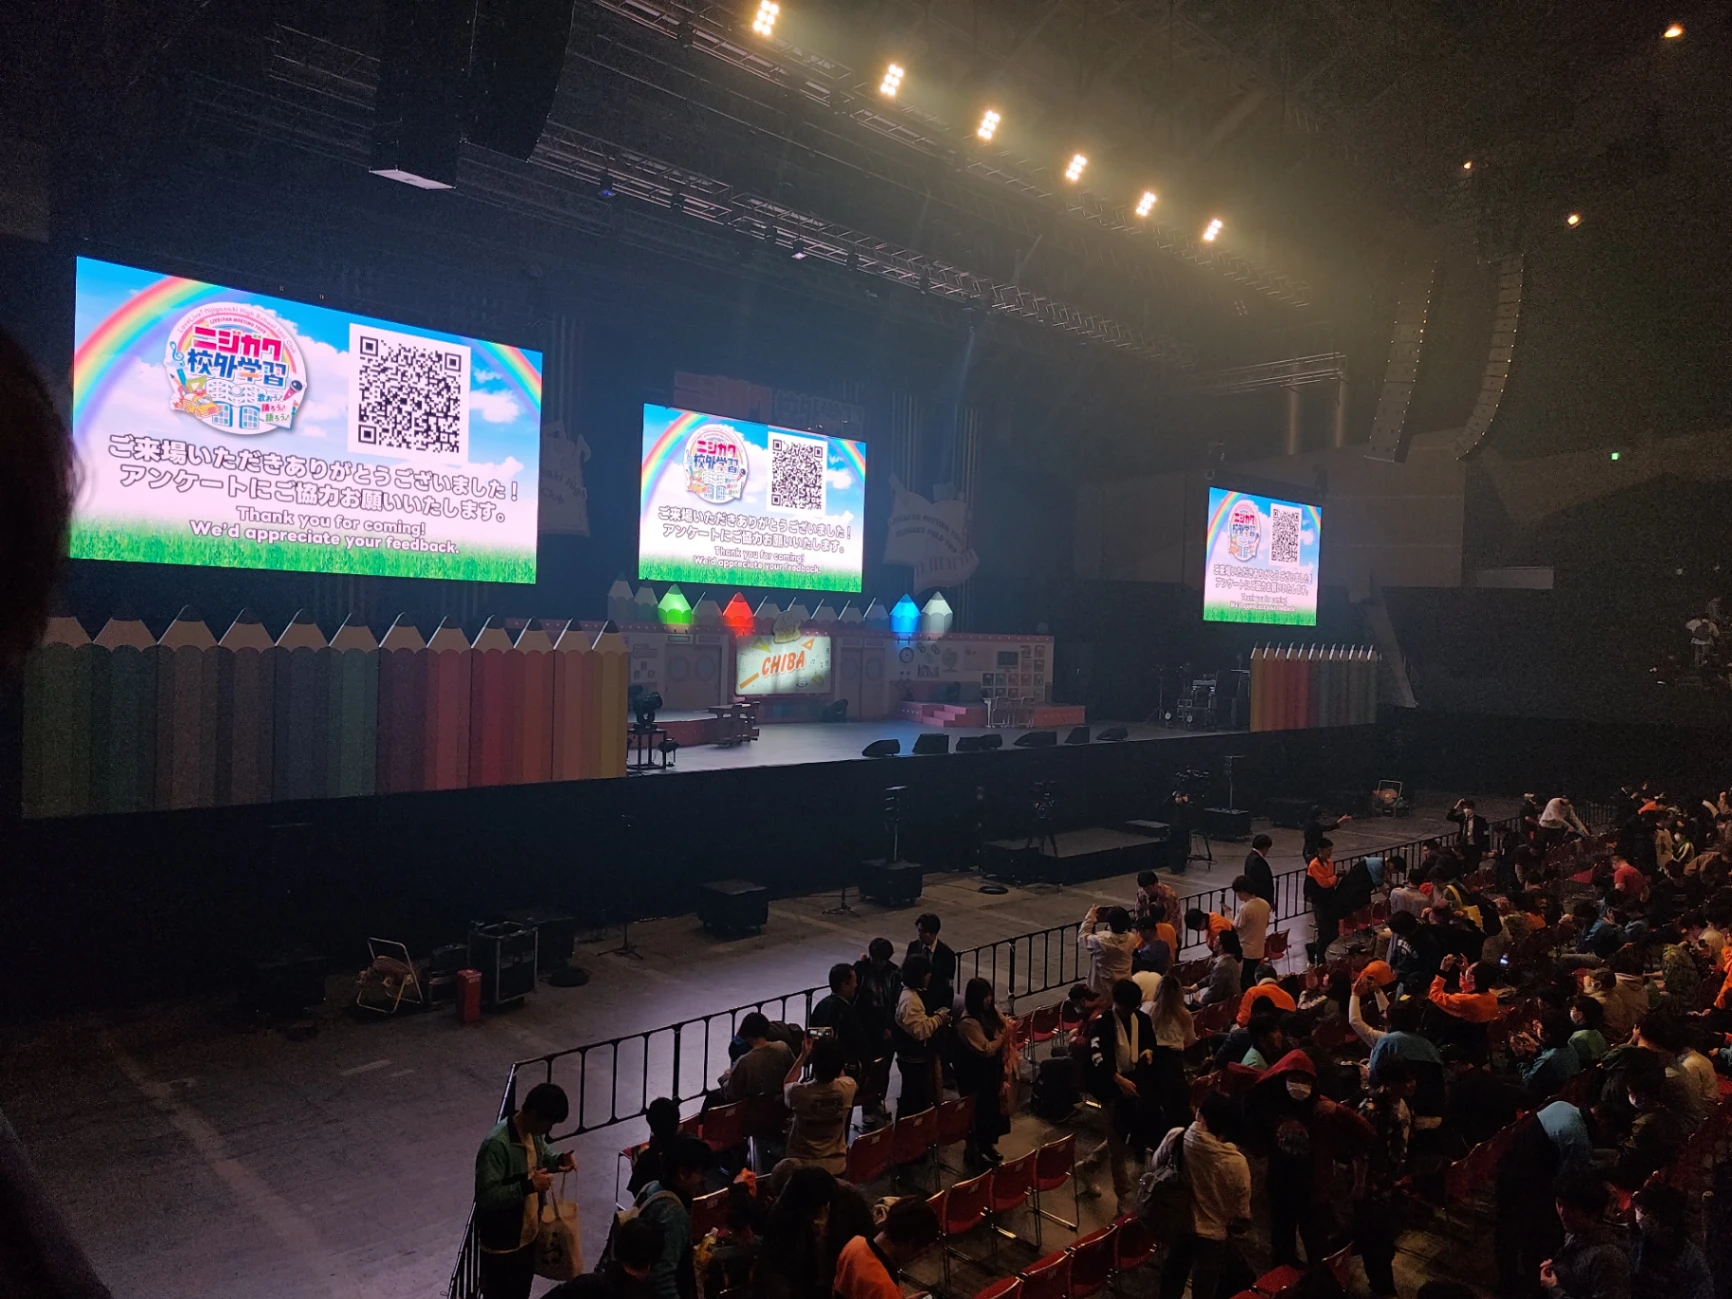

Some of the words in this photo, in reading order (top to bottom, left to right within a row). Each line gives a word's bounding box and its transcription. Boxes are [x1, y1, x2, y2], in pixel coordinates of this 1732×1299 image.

[193, 326, 282, 361] ニジガク
[187, 348, 287, 387] 校外学習
[108, 434, 518, 501] ご来場いただきありがとうございました!
[120, 464, 506, 522] アンケートにご協力お願いいたします。
[189, 520, 240, 538] We'd
[244, 525, 340, 545] appreciate
[344, 535, 382, 549] your
[385, 535, 460, 554] feedback.
[236, 506, 294, 525] Thank
[298, 514, 331, 530] you
[334, 514, 360, 530] for
[363, 518, 426, 538] coming!
[714, 545, 742, 557] Thank
[742, 550, 758, 560] you
[760, 550, 773, 560] for
[761, 650, 806, 678] CHIBA
